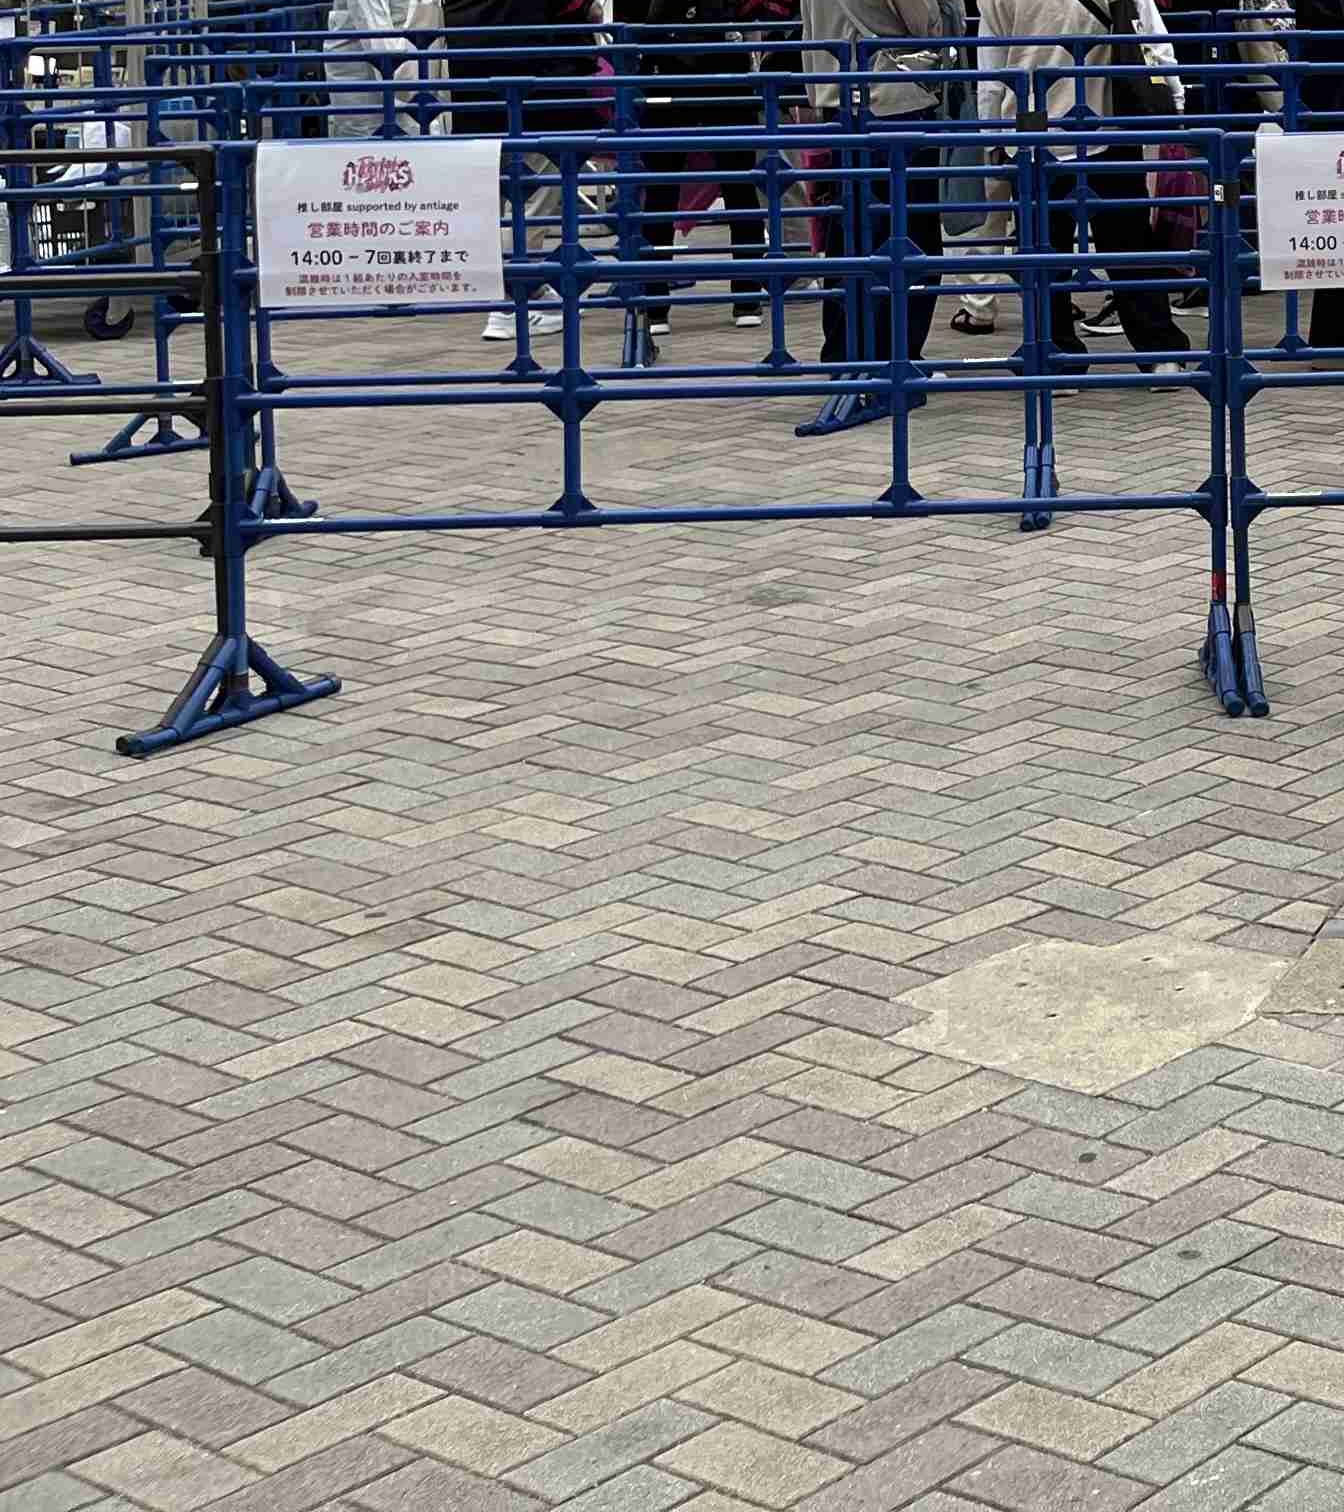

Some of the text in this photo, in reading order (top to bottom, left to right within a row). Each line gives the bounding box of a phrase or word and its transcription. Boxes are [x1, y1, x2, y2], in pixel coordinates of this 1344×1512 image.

[346, 202, 401, 213] supported
[404, 201, 417, 213] by
[419, 200, 459, 212] antiage
[306, 220, 449, 238] 営業時間のご案内
[1289, 235, 1337, 251] 14:00
[290, 249, 343, 266] 14:00
